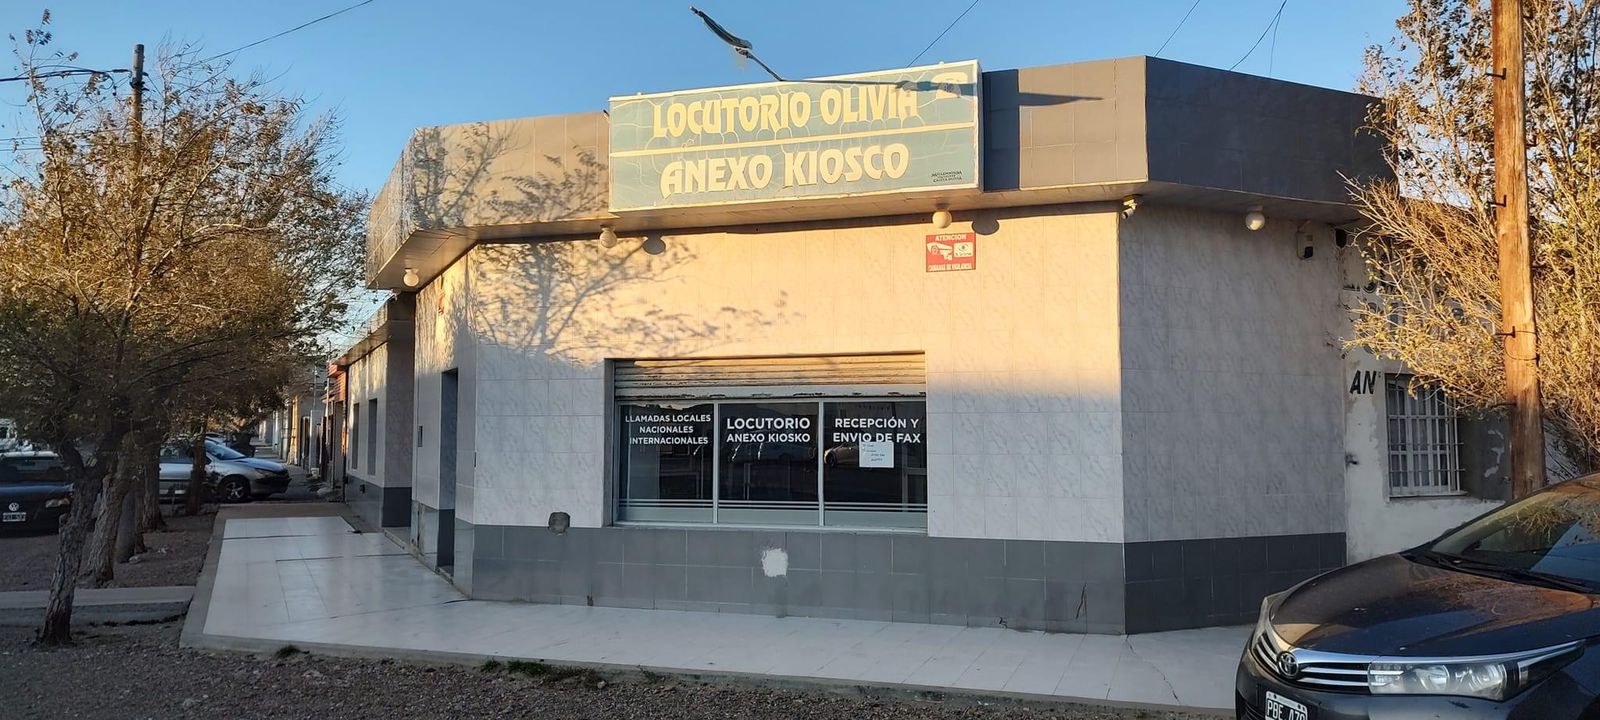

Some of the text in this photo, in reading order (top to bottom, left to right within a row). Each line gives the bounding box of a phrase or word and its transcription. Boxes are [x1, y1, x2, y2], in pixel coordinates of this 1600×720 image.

[653, 84, 918, 138] LOCUTORIO OLIVIA
[660, 143, 910, 199] ANEXO KIOSCO
[625, 414, 711, 423] LLAMADAS LOCALES
[726, 417, 811, 430] LOCUTORIO
[835, 416, 919, 429] RECEPCIÓN Y
[639, 425, 694, 434] NACIONALES
[630, 437, 709, 445] INTERNACIONALES
[726, 433, 811, 443] ANEXO KIOSKO
[833, 432, 921, 443] ENVIO DE FAX
[1267, 700, 1284, 720] PBE
